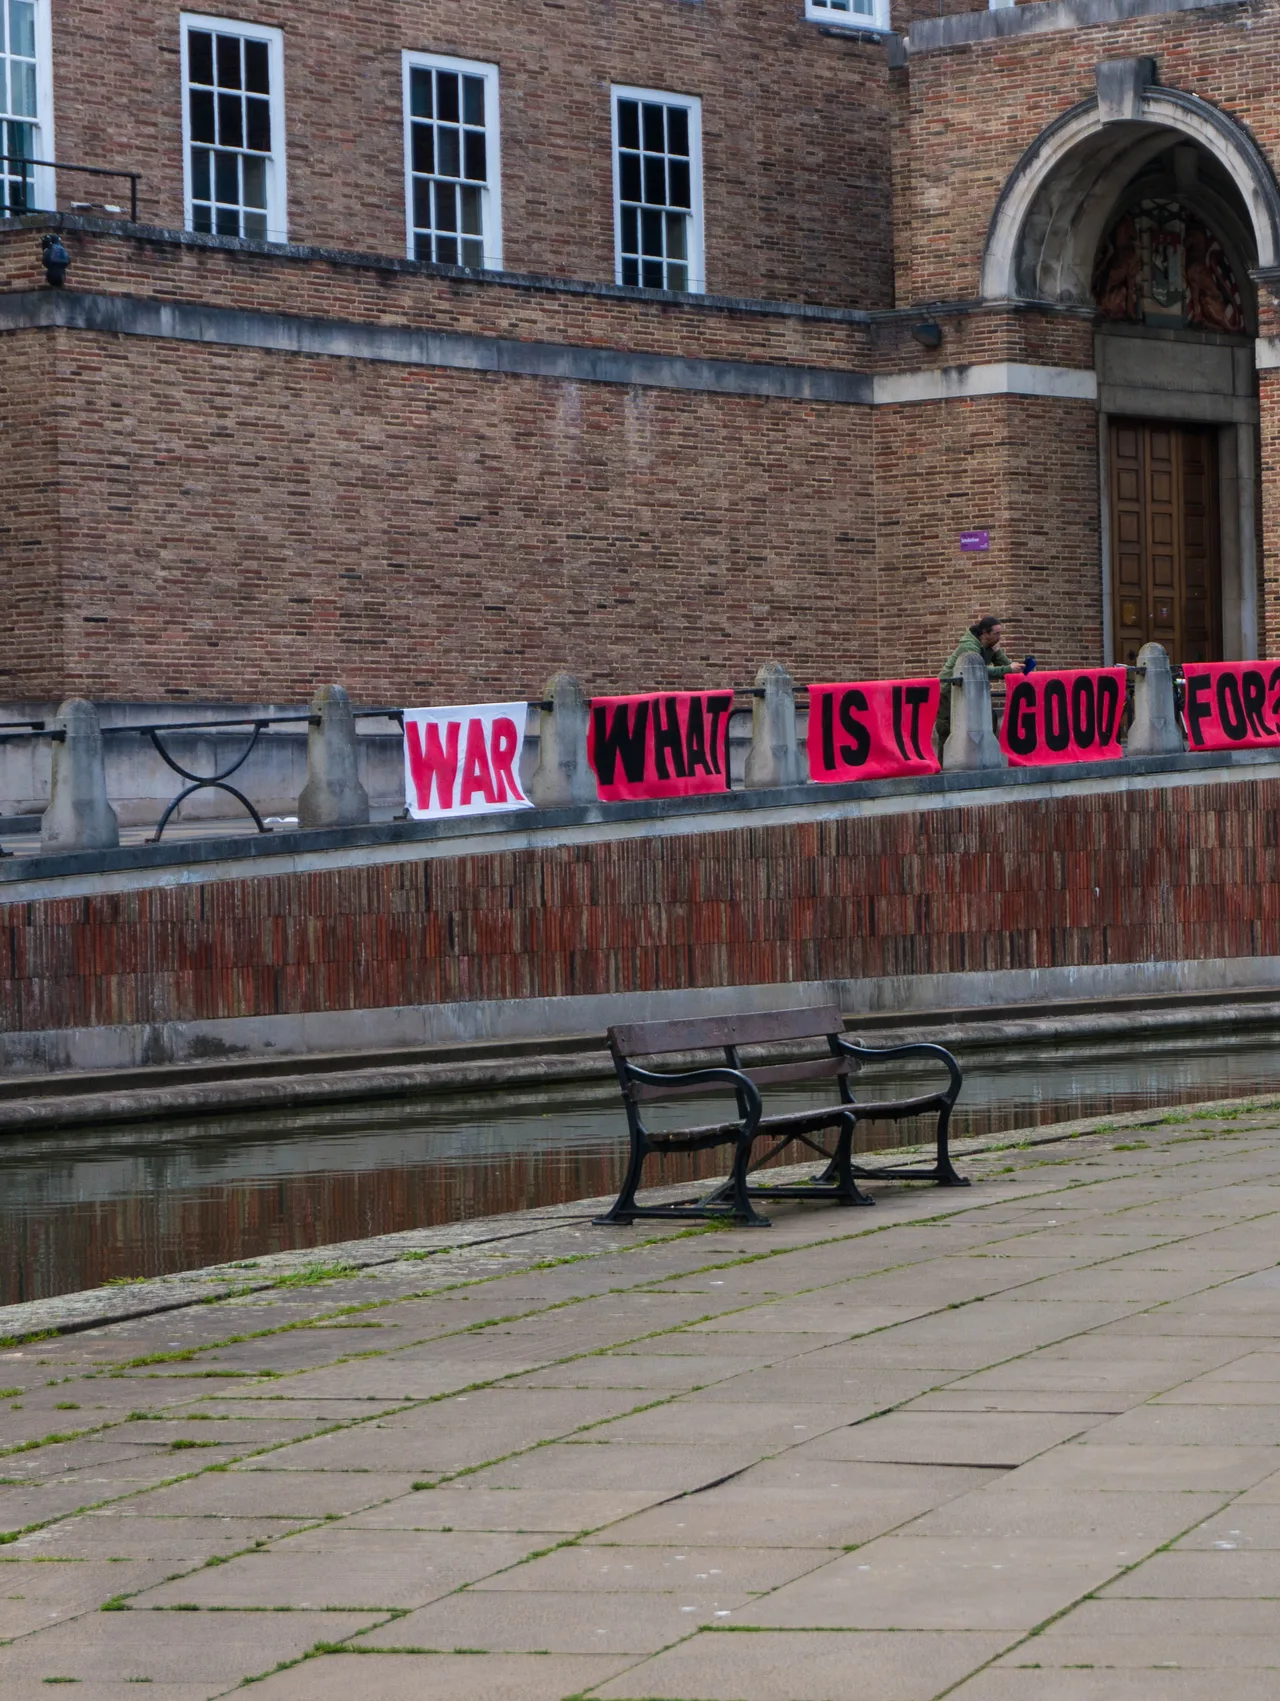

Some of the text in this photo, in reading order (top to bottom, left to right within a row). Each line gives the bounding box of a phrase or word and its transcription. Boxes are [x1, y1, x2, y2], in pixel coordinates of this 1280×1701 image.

[593, 696, 732, 785] WHAT
[822, 686, 930, 771] IS IT
[1007, 675, 1119, 755] GOOD
[405, 718, 524, 810] WAR
